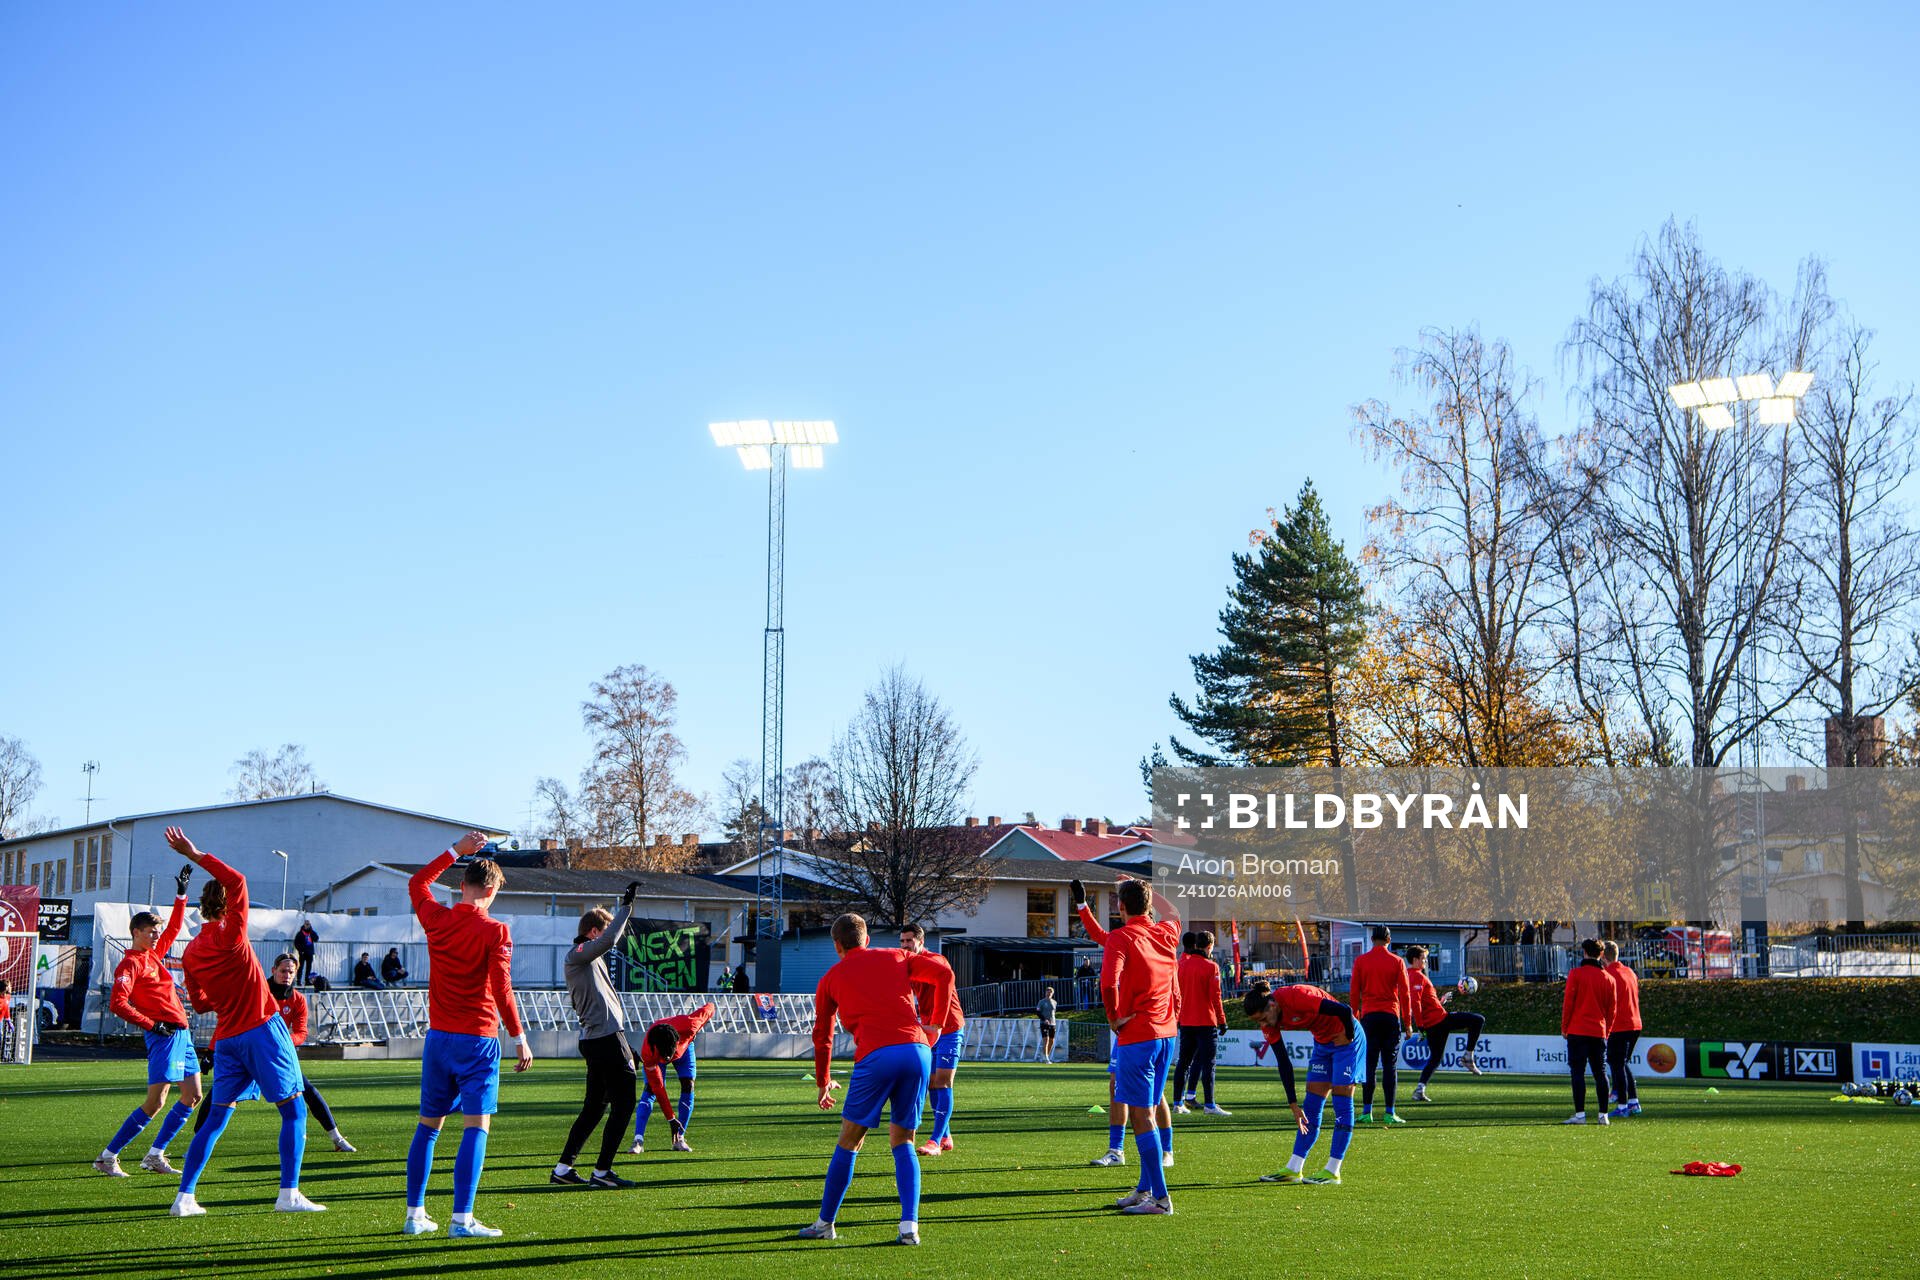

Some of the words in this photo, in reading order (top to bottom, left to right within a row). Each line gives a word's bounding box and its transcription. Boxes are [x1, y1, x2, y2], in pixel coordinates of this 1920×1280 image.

[627, 926, 700, 964] NEXT
[629, 958, 697, 993] SIGN
[1286, 1041, 1314, 1059] ÄST
[1405, 1045, 1431, 1060] BW
[1455, 1037, 1491, 1053] Bst
[1441, 1052, 1506, 1069] Wetern
[1536, 1048, 1567, 1063] Fasti
[1798, 1052, 1833, 1072] XL
